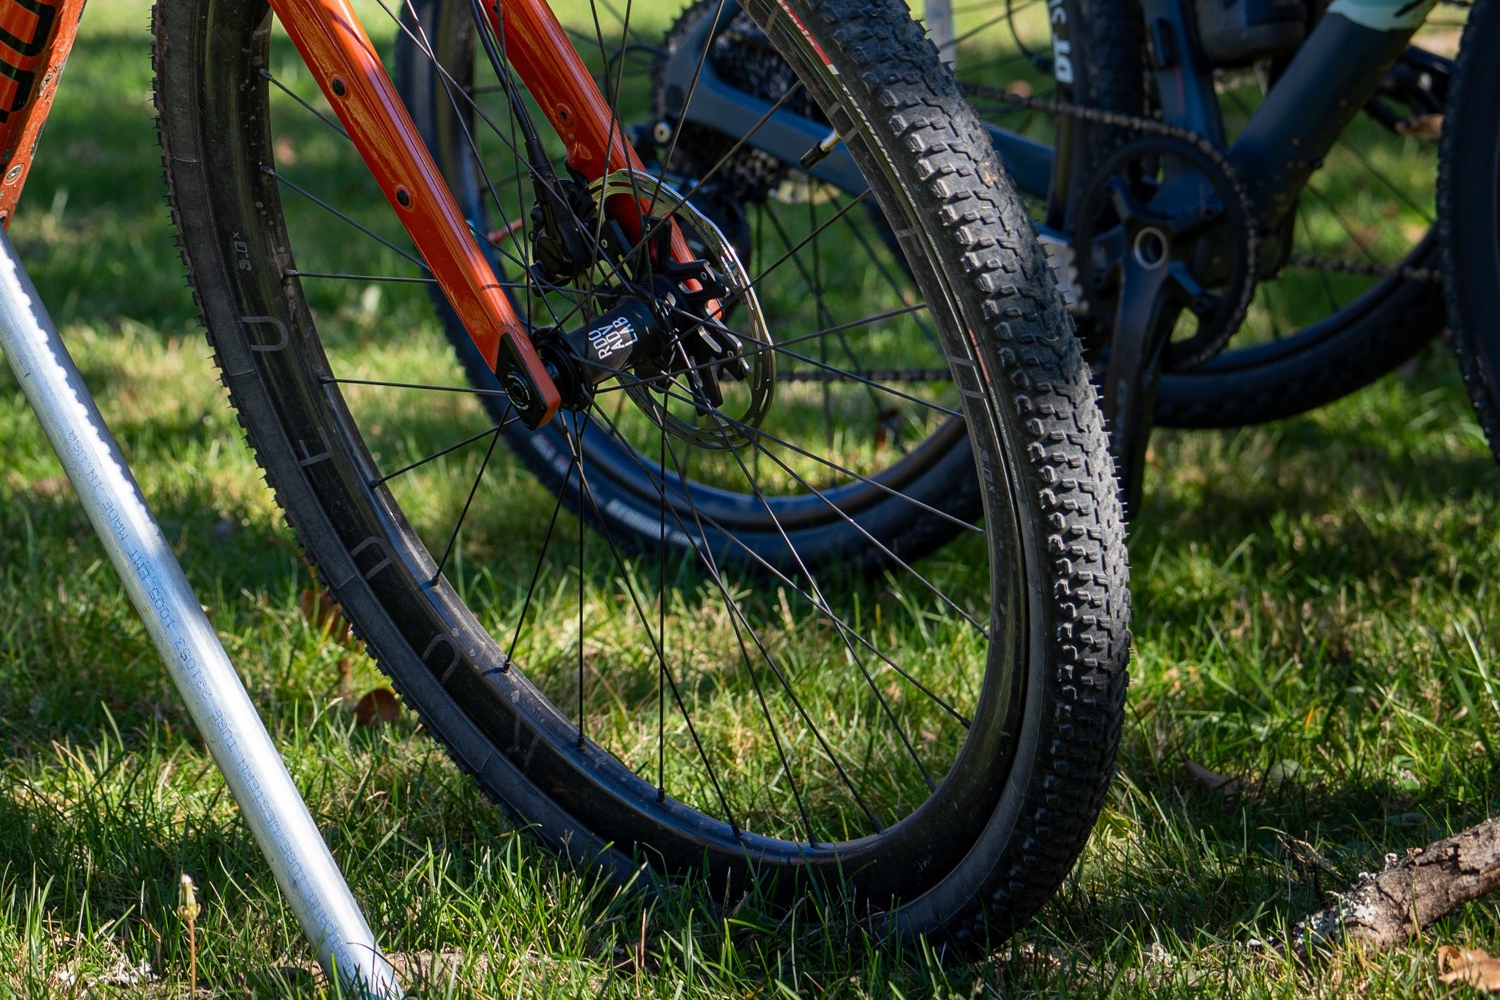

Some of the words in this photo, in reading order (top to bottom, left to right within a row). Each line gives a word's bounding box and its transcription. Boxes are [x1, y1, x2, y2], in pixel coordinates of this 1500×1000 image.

[1053, 32, 1074, 84] DT
[588, 329, 613, 360] RDO
[598, 324, 625, 351] ADV
[612, 316, 639, 347] LAB
[101, 498, 130, 540] MADE
[126, 546, 151, 580] EMT
[146, 585, 176, 629] 1005
[171, 635, 213, 700] 221053
[209, 707, 240, 752] TUBE
[305, 892, 360, 982] HEATLAND
